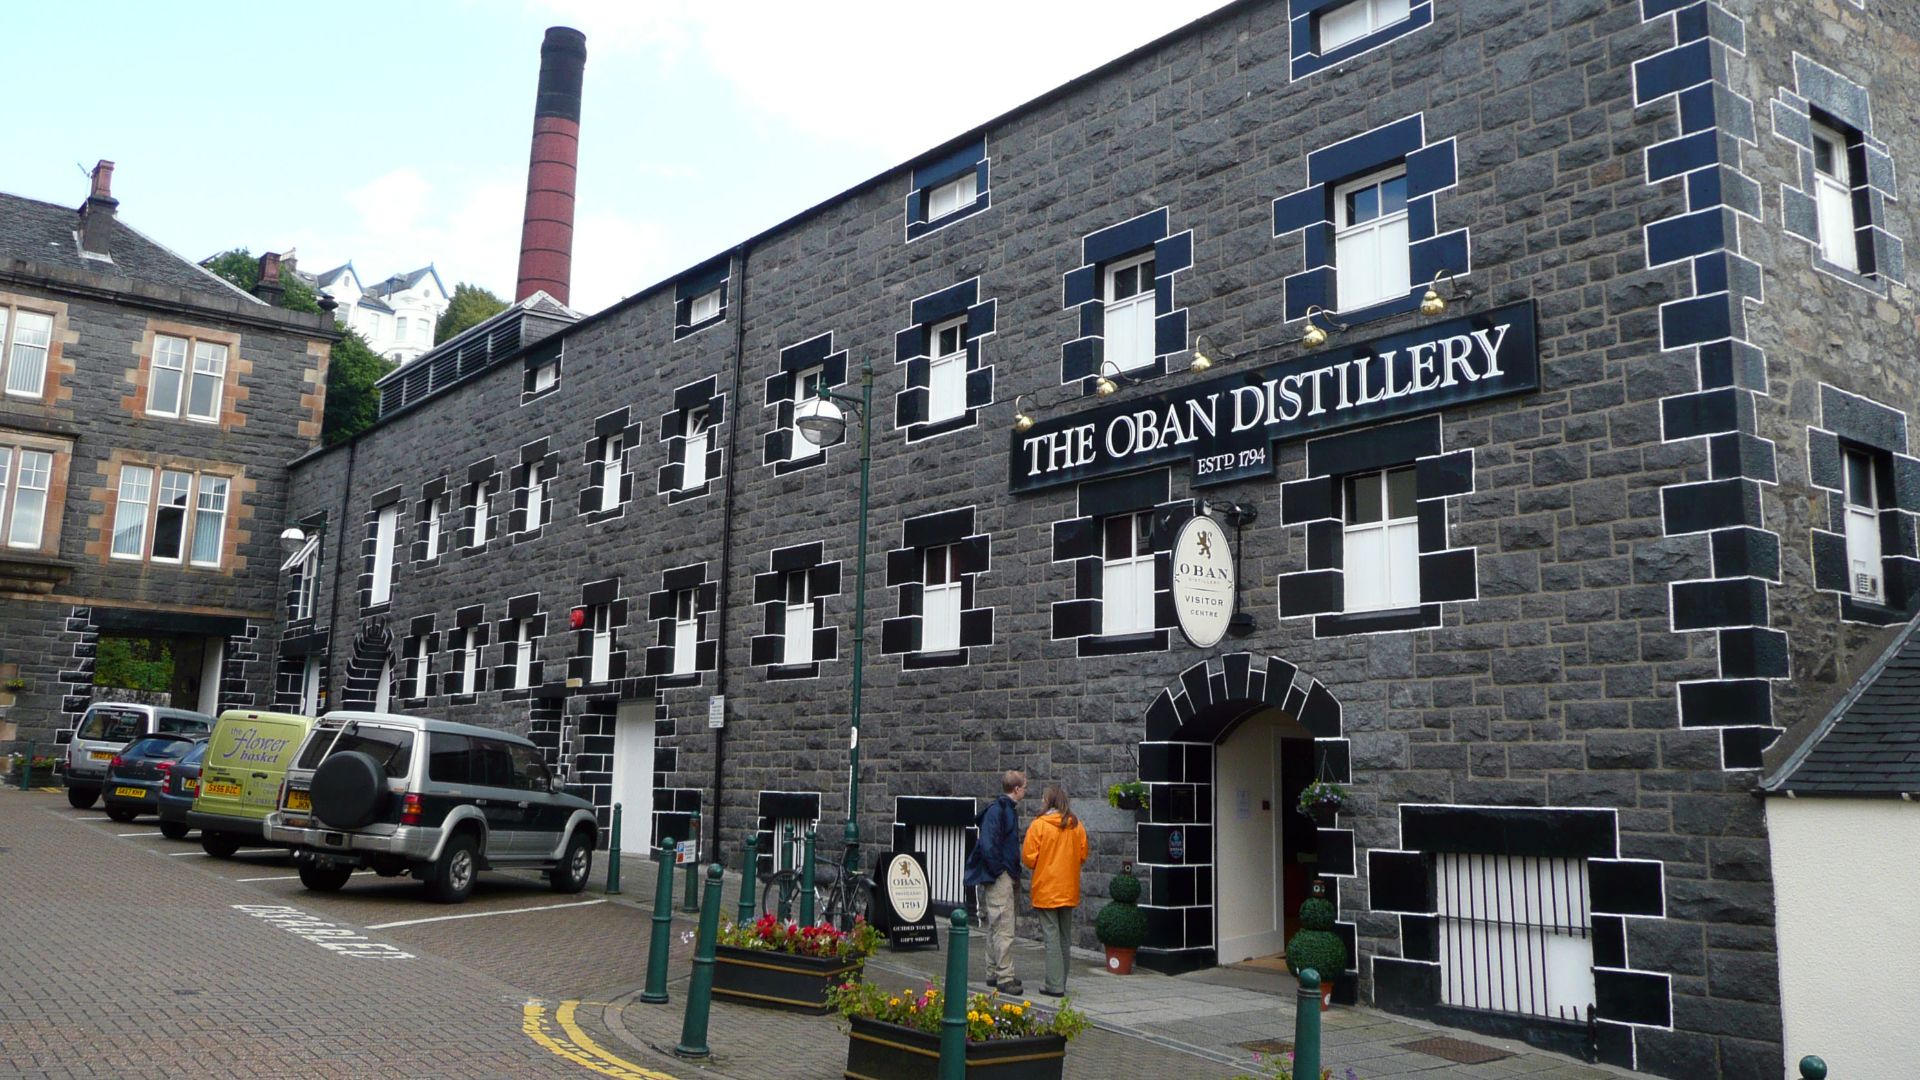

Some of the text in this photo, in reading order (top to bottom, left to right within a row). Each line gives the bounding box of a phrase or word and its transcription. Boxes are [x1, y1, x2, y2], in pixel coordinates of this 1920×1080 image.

[1023, 323, 1511, 476] THE OBAN DISTILLERY
[1238, 447, 1266, 467] 1794
[1180, 562, 1228, 580] OBAN
[1185, 595, 1224, 606] VISITOR
[1190, 609, 1218, 618] CENTRE
[231, 727, 243, 736] the
[223, 727, 290, 759] flower
[240, 750, 279, 763] basket
[893, 878, 922, 886] OBAN
